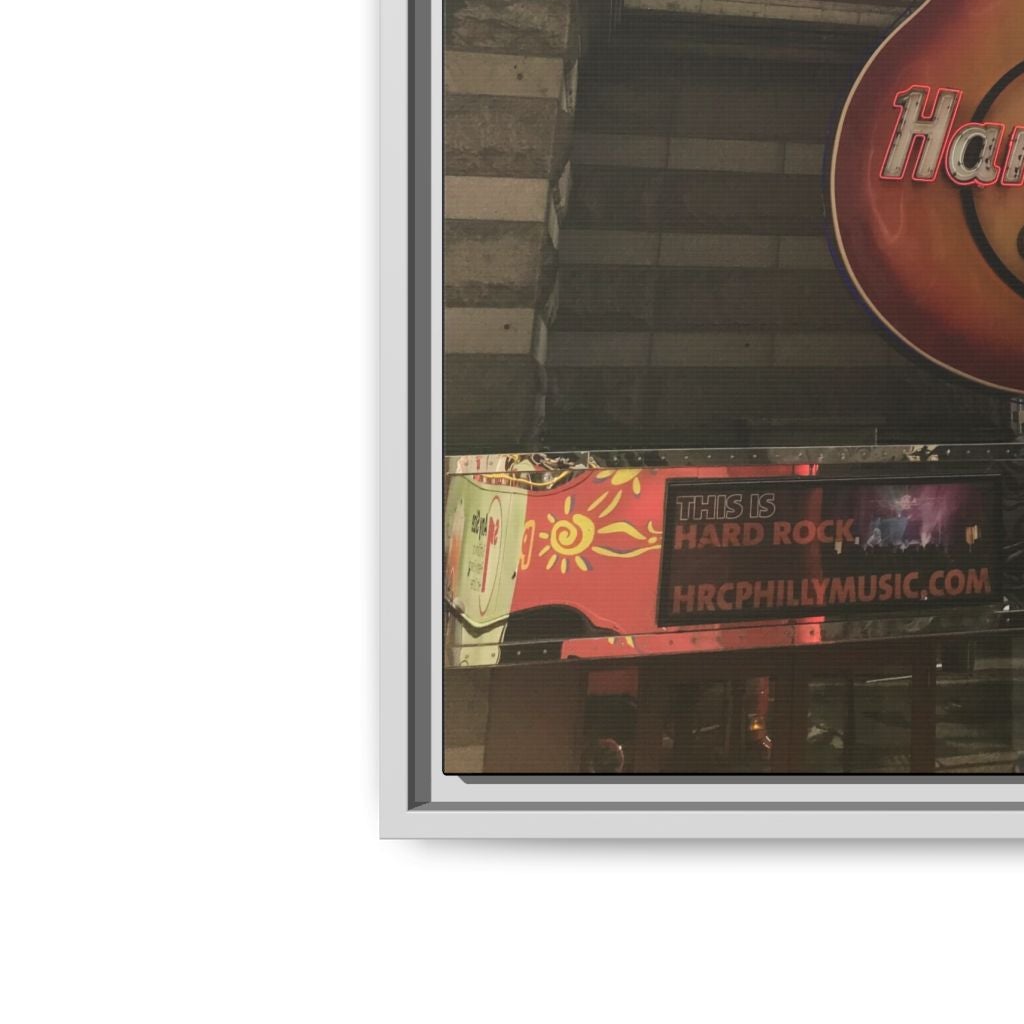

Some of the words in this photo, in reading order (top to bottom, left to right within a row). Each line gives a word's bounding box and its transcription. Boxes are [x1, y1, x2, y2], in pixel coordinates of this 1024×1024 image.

[676, 493, 743, 521] THIS
[749, 492, 776, 519] IS
[673, 522, 765, 550] HARD
[672, 568, 992, 614] HRCPHILLYMUSIC.COM
